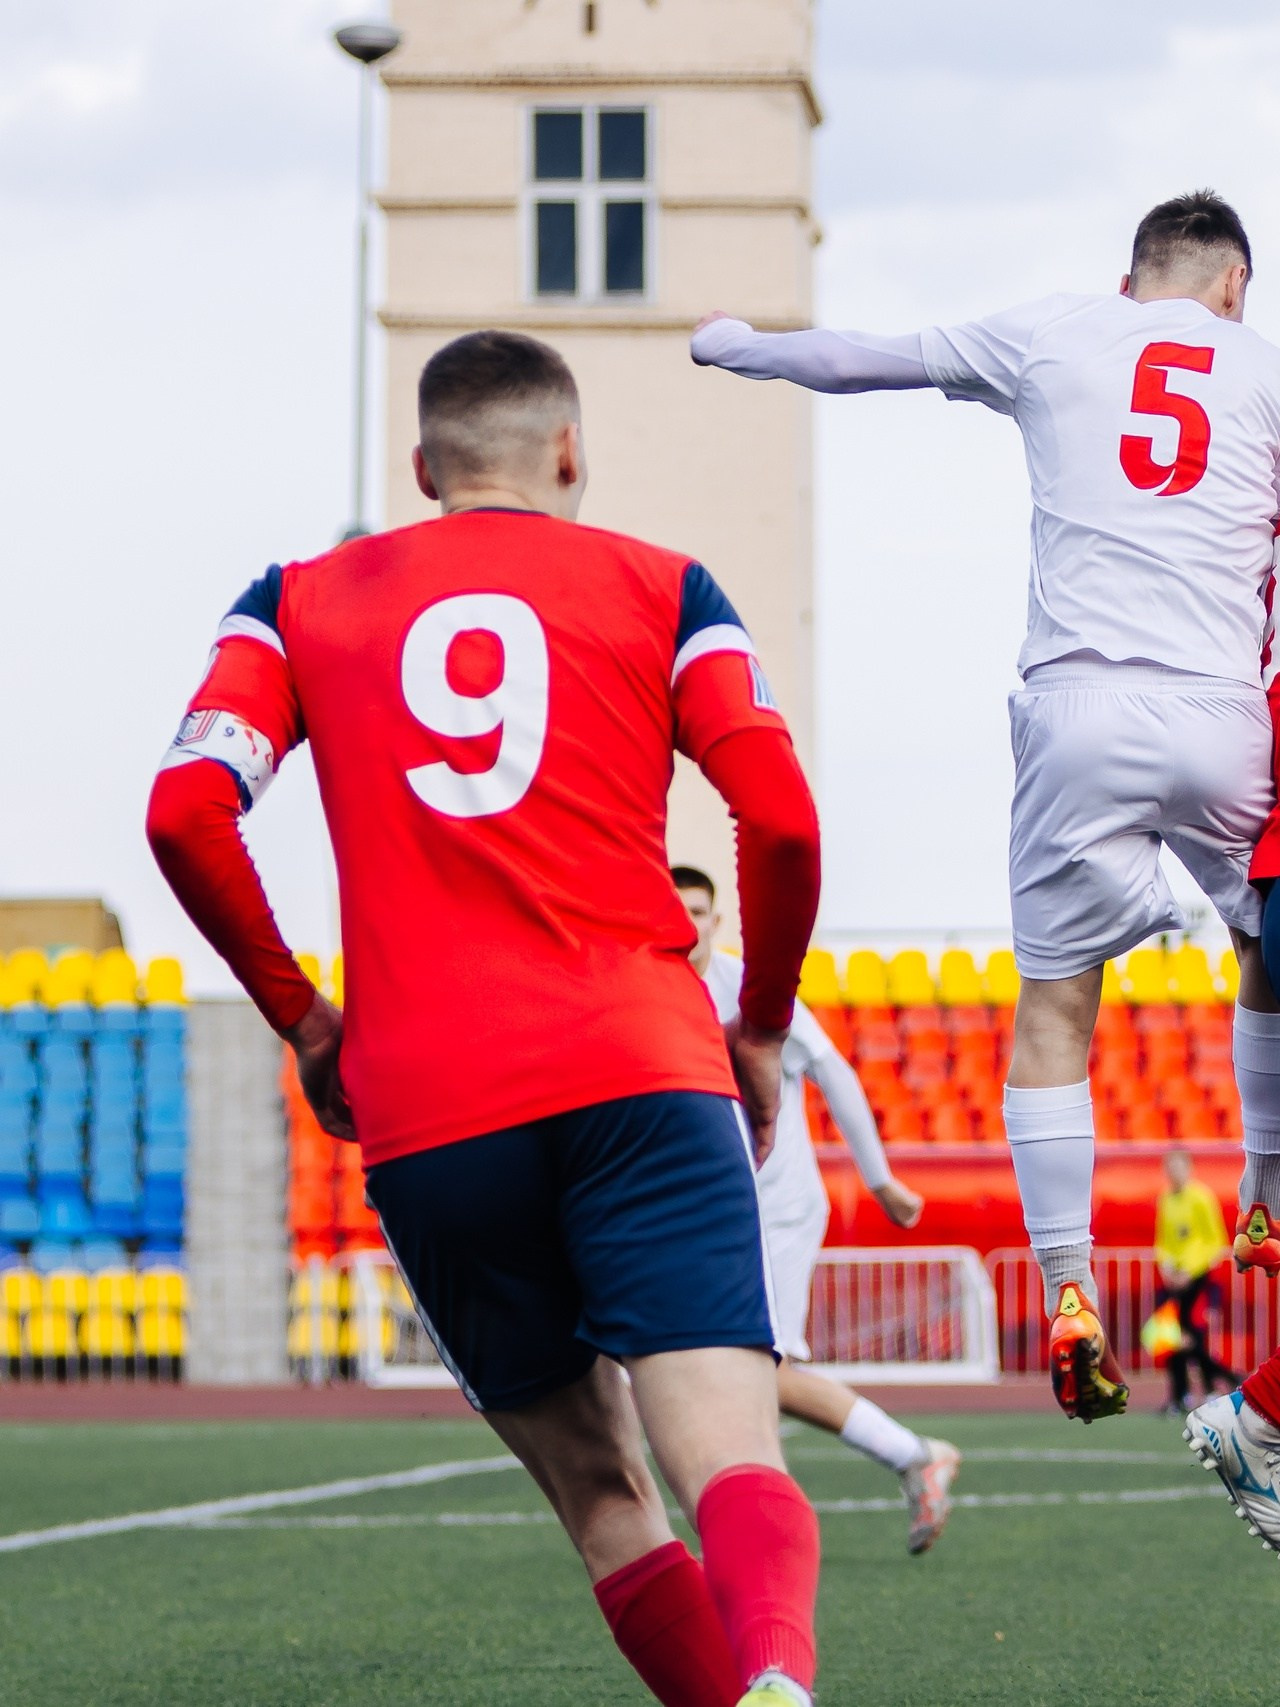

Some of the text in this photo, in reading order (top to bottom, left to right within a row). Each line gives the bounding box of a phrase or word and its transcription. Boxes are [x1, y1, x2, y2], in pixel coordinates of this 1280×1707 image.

[1120, 342, 1215, 496] 5
[223, 726, 235, 738] 9
[402, 594, 548, 817] 9
